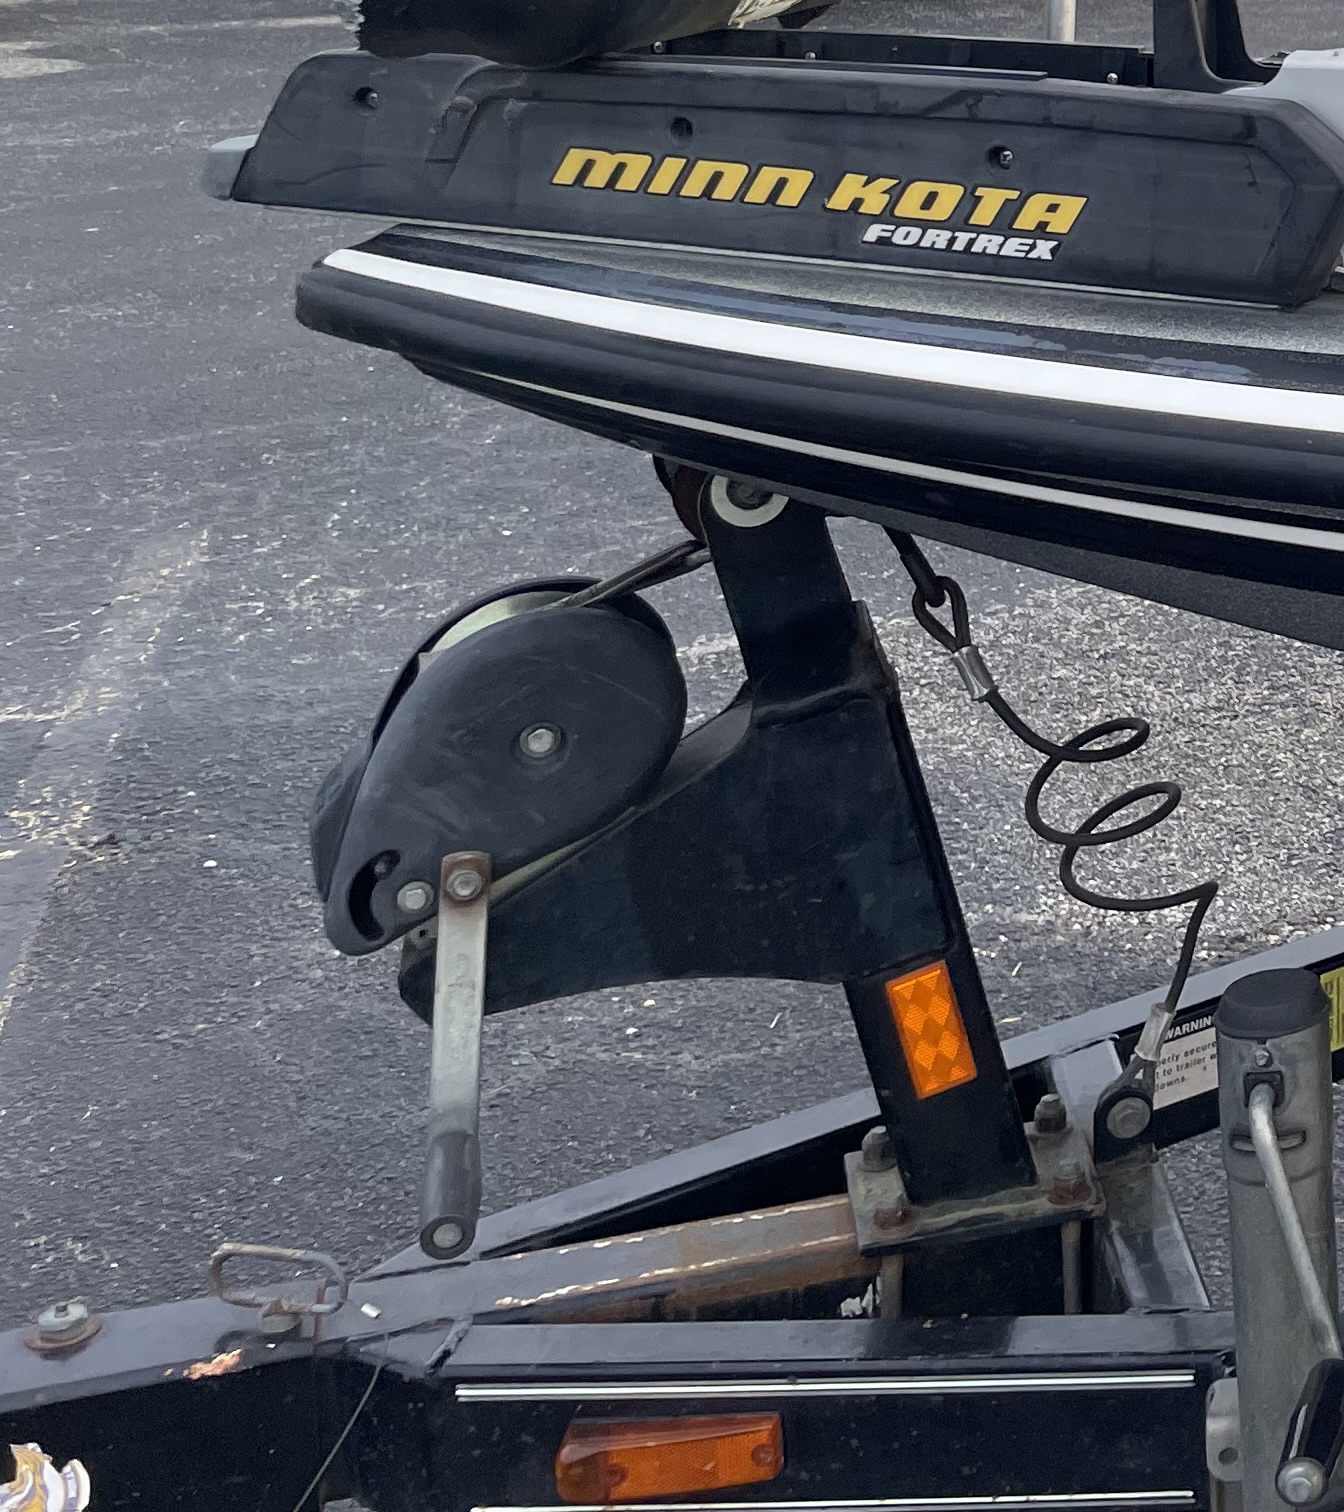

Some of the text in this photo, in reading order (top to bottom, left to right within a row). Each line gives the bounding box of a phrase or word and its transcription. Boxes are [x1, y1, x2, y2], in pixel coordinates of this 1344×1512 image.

[550, 146, 1088, 235] MINN KOTA
[861, 224, 1062, 260] FORTREX
[1165, 1015, 1212, 1040] WARNIN
[1176, 1056, 1206, 1072] trailer
